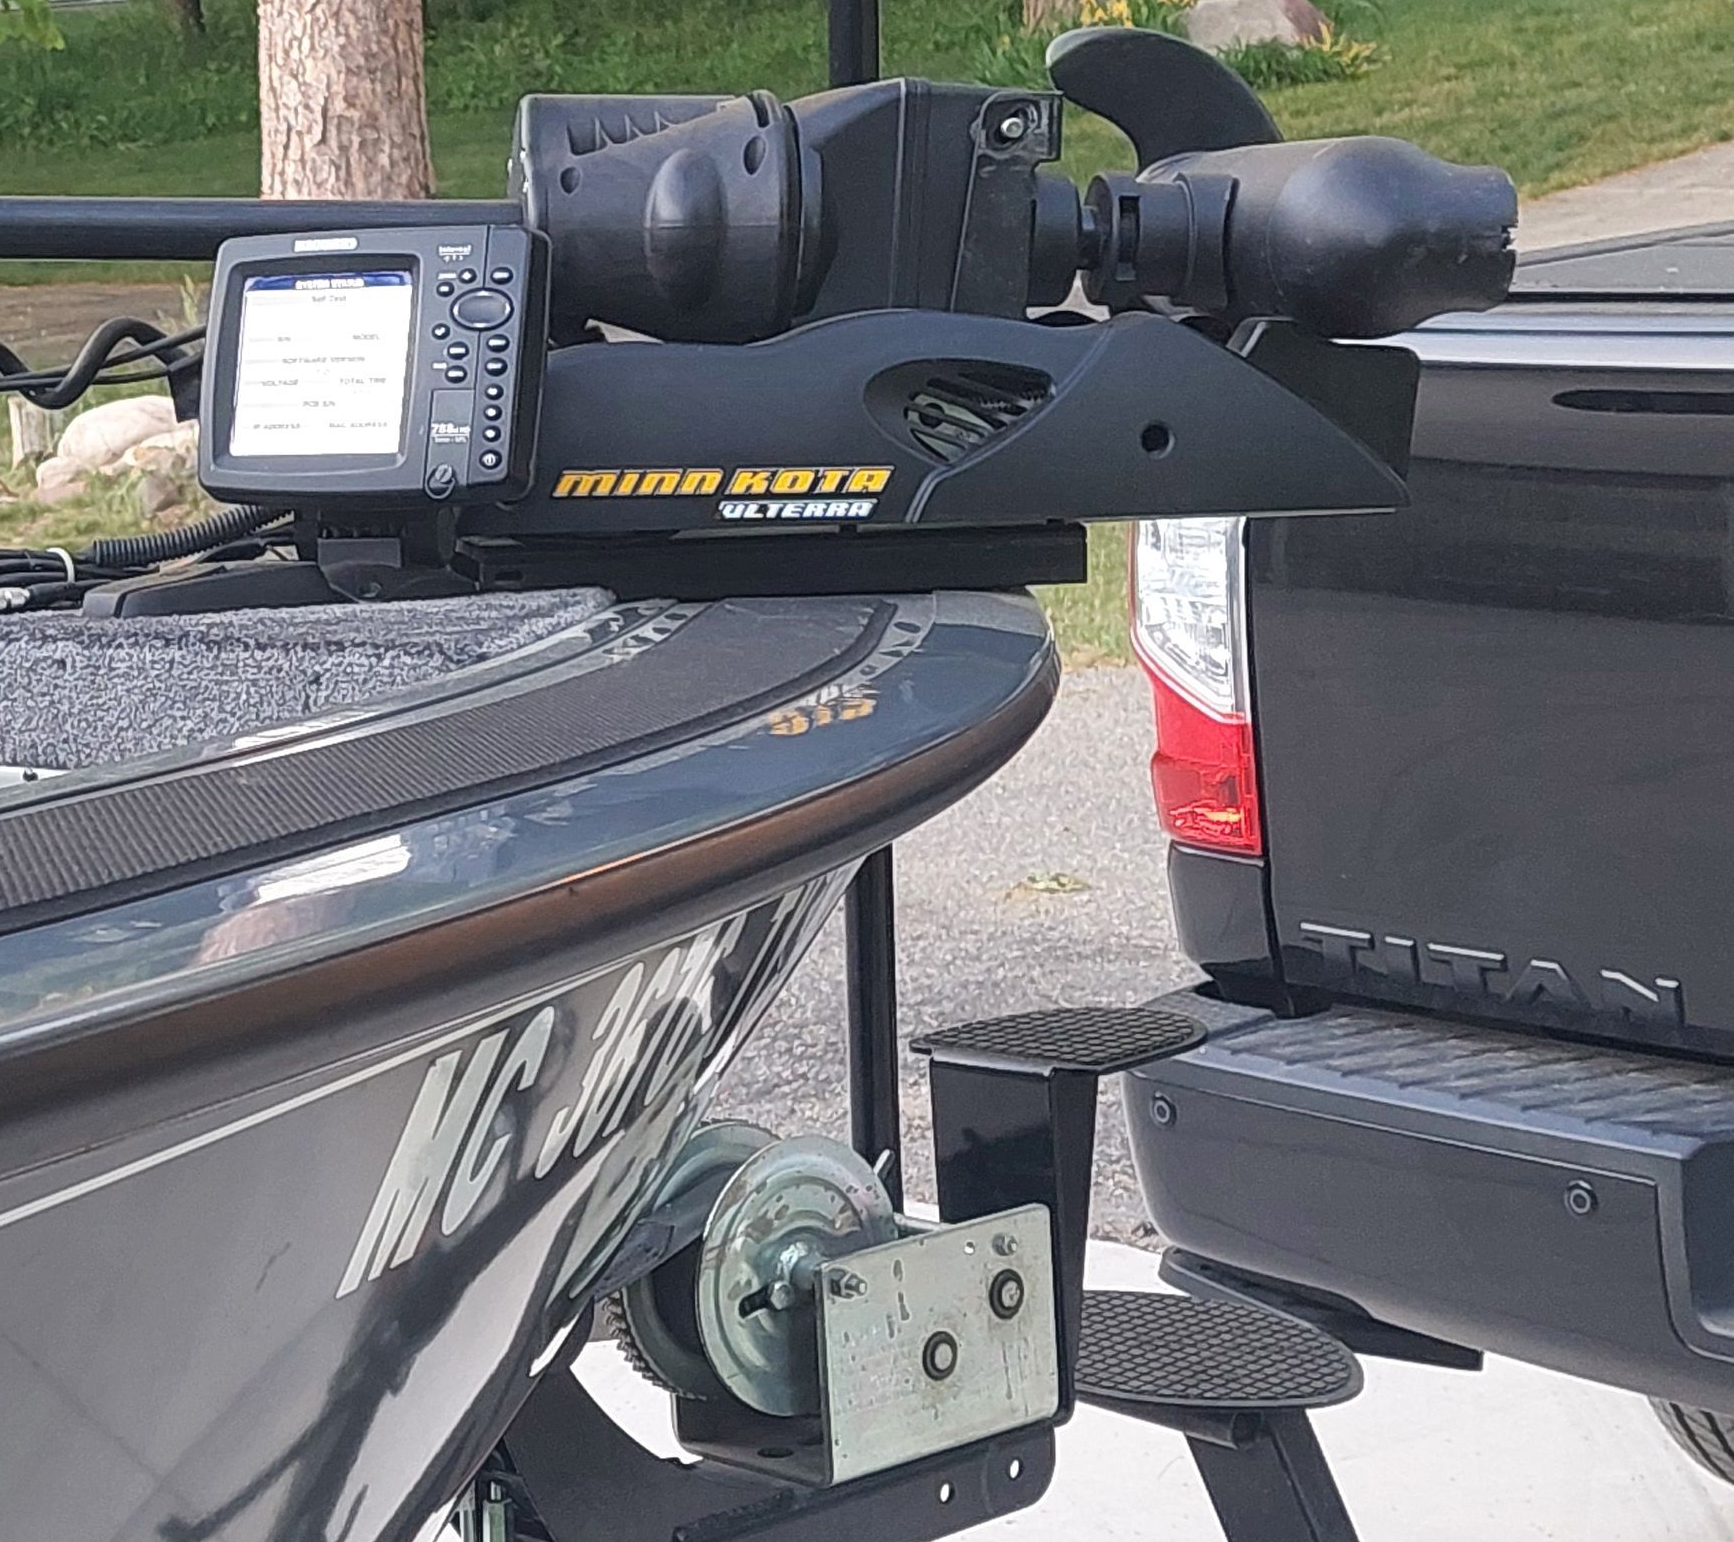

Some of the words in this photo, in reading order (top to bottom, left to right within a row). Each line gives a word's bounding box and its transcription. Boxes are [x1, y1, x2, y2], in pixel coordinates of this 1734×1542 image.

[718, 500, 879, 520] ULTERRA
[724, 465, 895, 495] KOTA
[1299, 921, 1686, 1027] TITAN
[334, 1005, 556, 1300] MC
